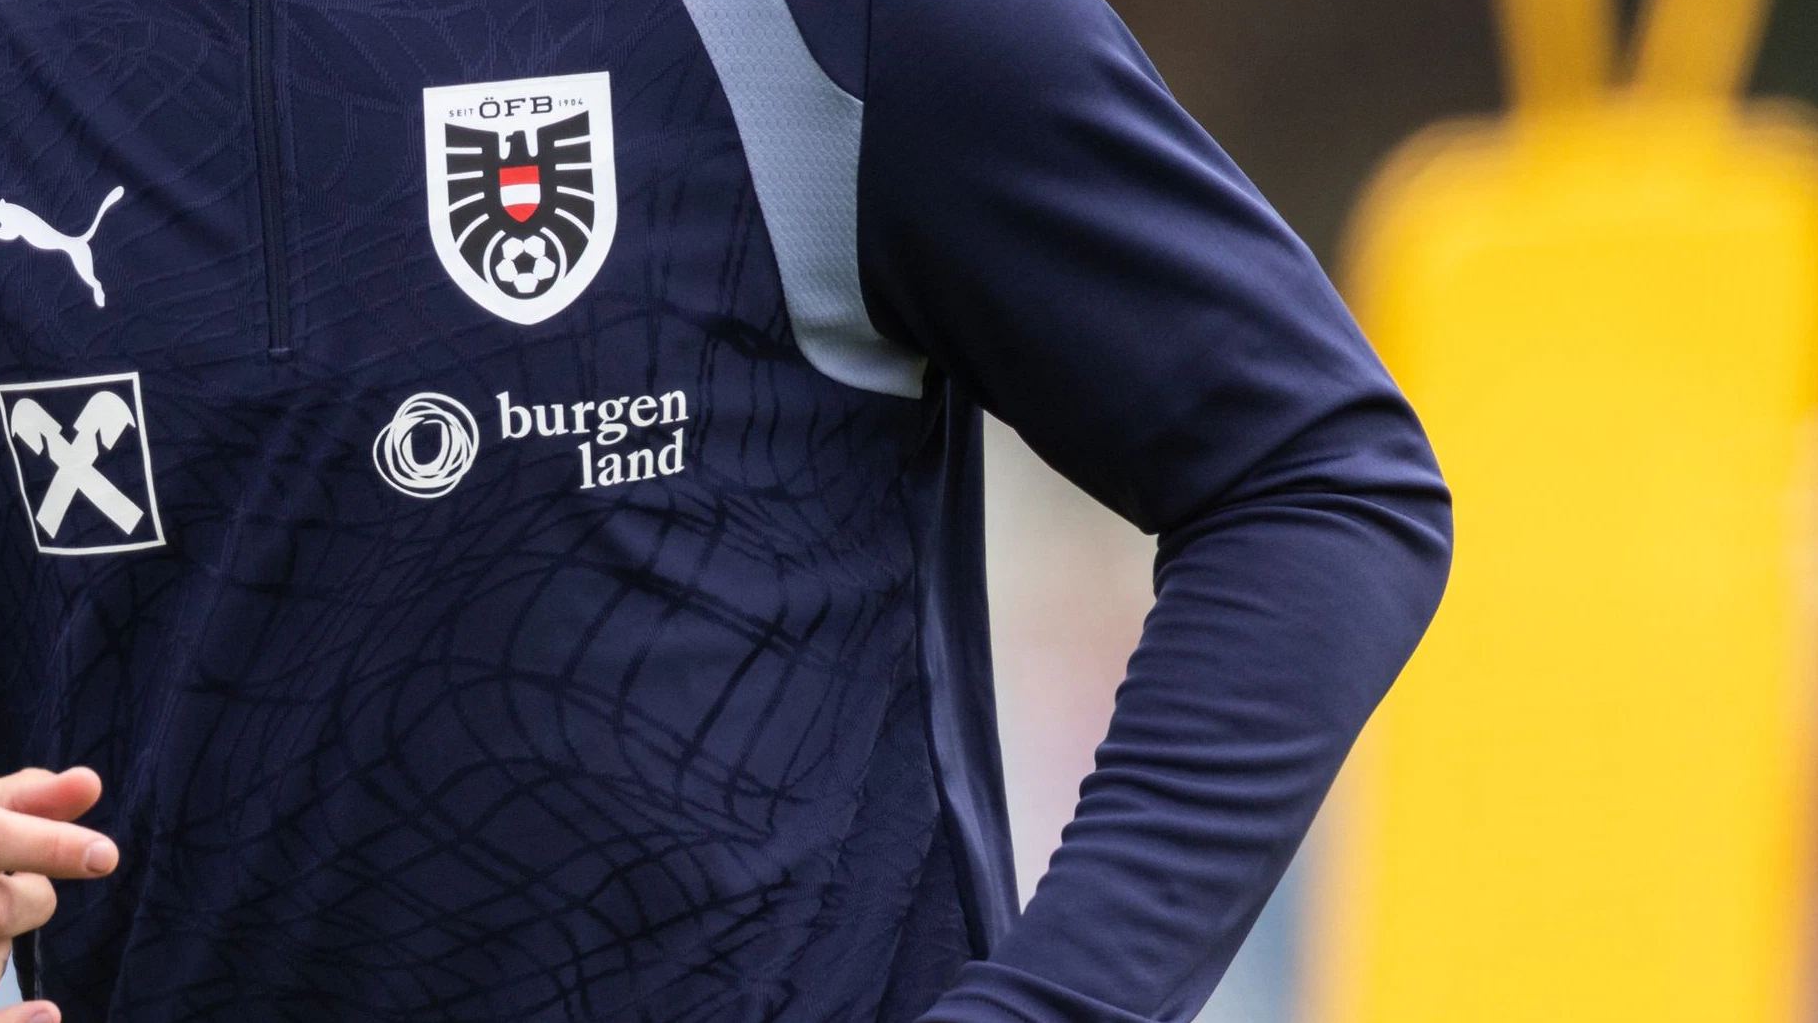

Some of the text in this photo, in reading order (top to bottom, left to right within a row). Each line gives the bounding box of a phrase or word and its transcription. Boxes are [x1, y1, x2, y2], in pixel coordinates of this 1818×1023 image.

[448, 95, 584, 119] SEIT ÖFB 1904
[496, 389, 690, 446] burgen
[578, 428, 685, 490] land
